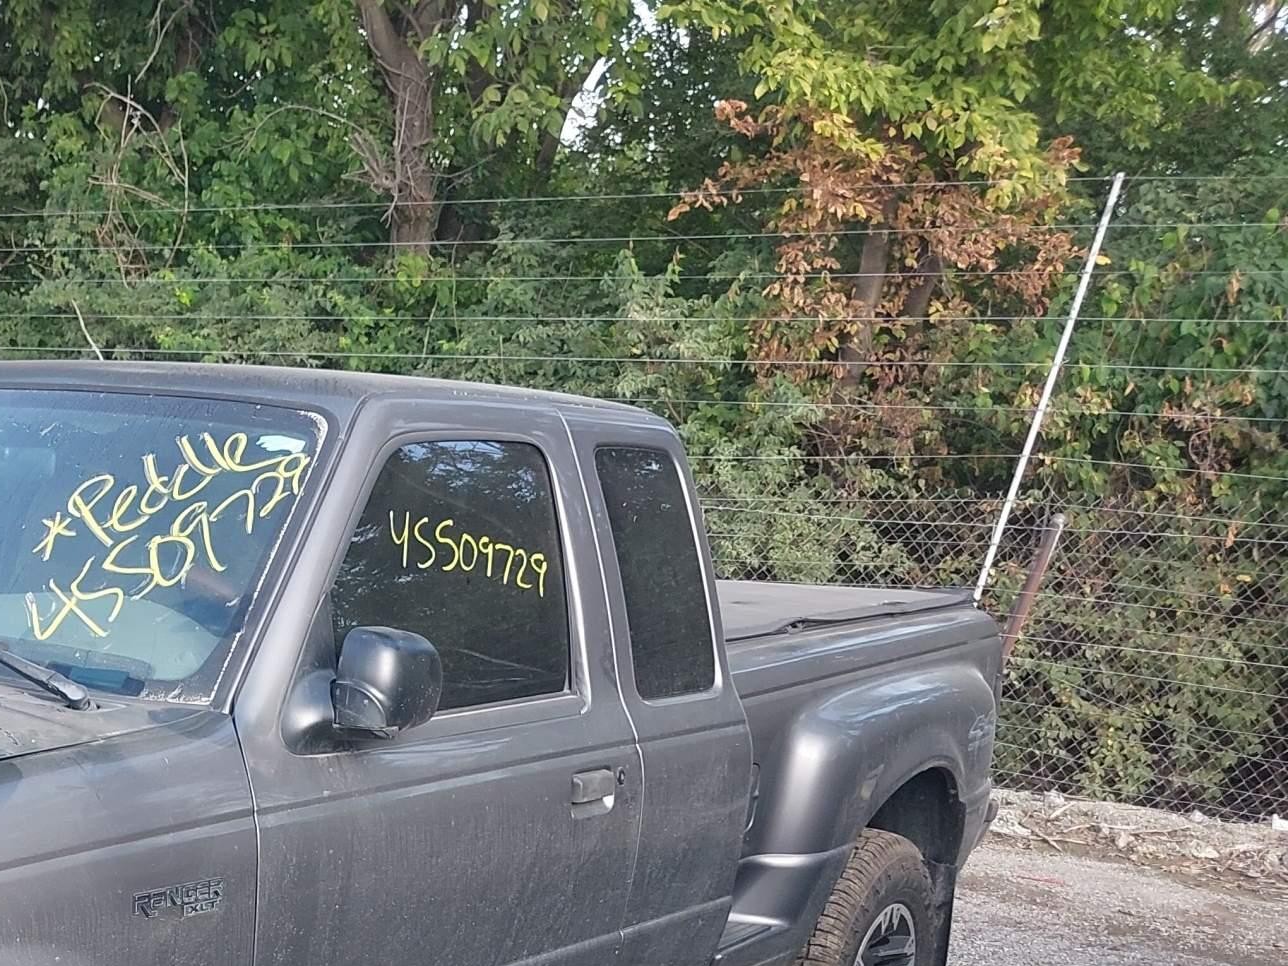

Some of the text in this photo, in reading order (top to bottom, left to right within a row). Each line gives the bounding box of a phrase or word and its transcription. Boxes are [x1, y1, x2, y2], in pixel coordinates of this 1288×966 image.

[25, 452, 311, 641] 45509729
[389, 510, 548, 598] 45509729
[133, 877, 224, 919] RANGER
[185, 900, 220, 917] XLT
